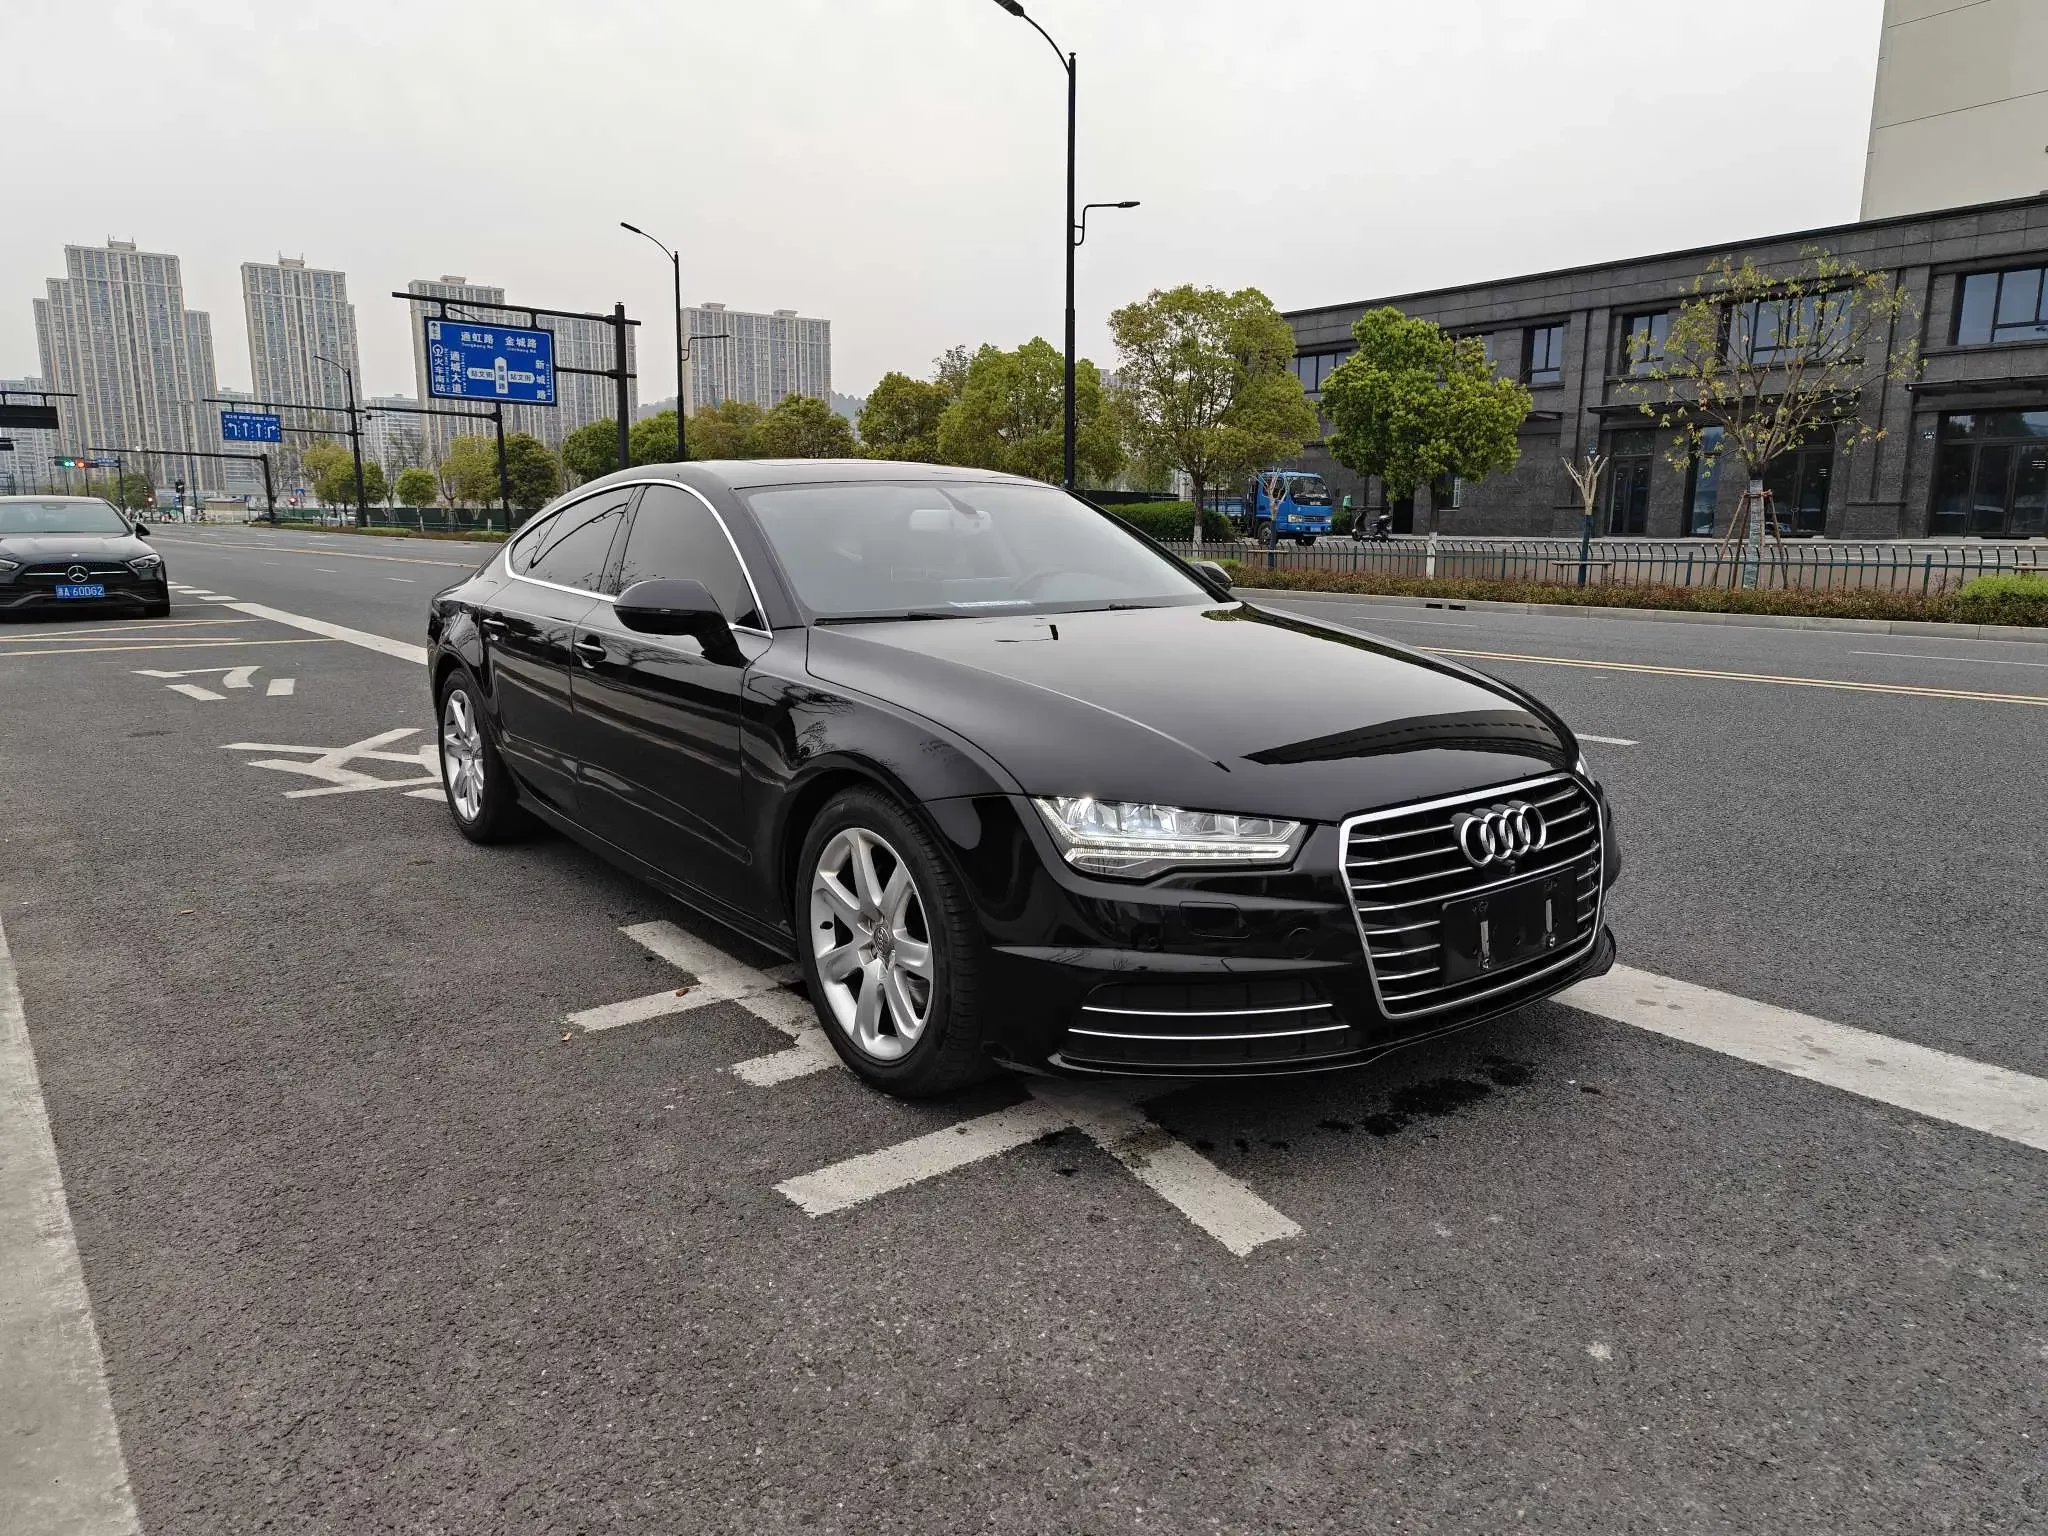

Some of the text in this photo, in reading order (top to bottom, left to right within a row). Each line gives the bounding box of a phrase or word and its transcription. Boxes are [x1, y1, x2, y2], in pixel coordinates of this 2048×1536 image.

[504, 336, 537, 348] 金城路
[434, 358, 446, 392] 火车南站
